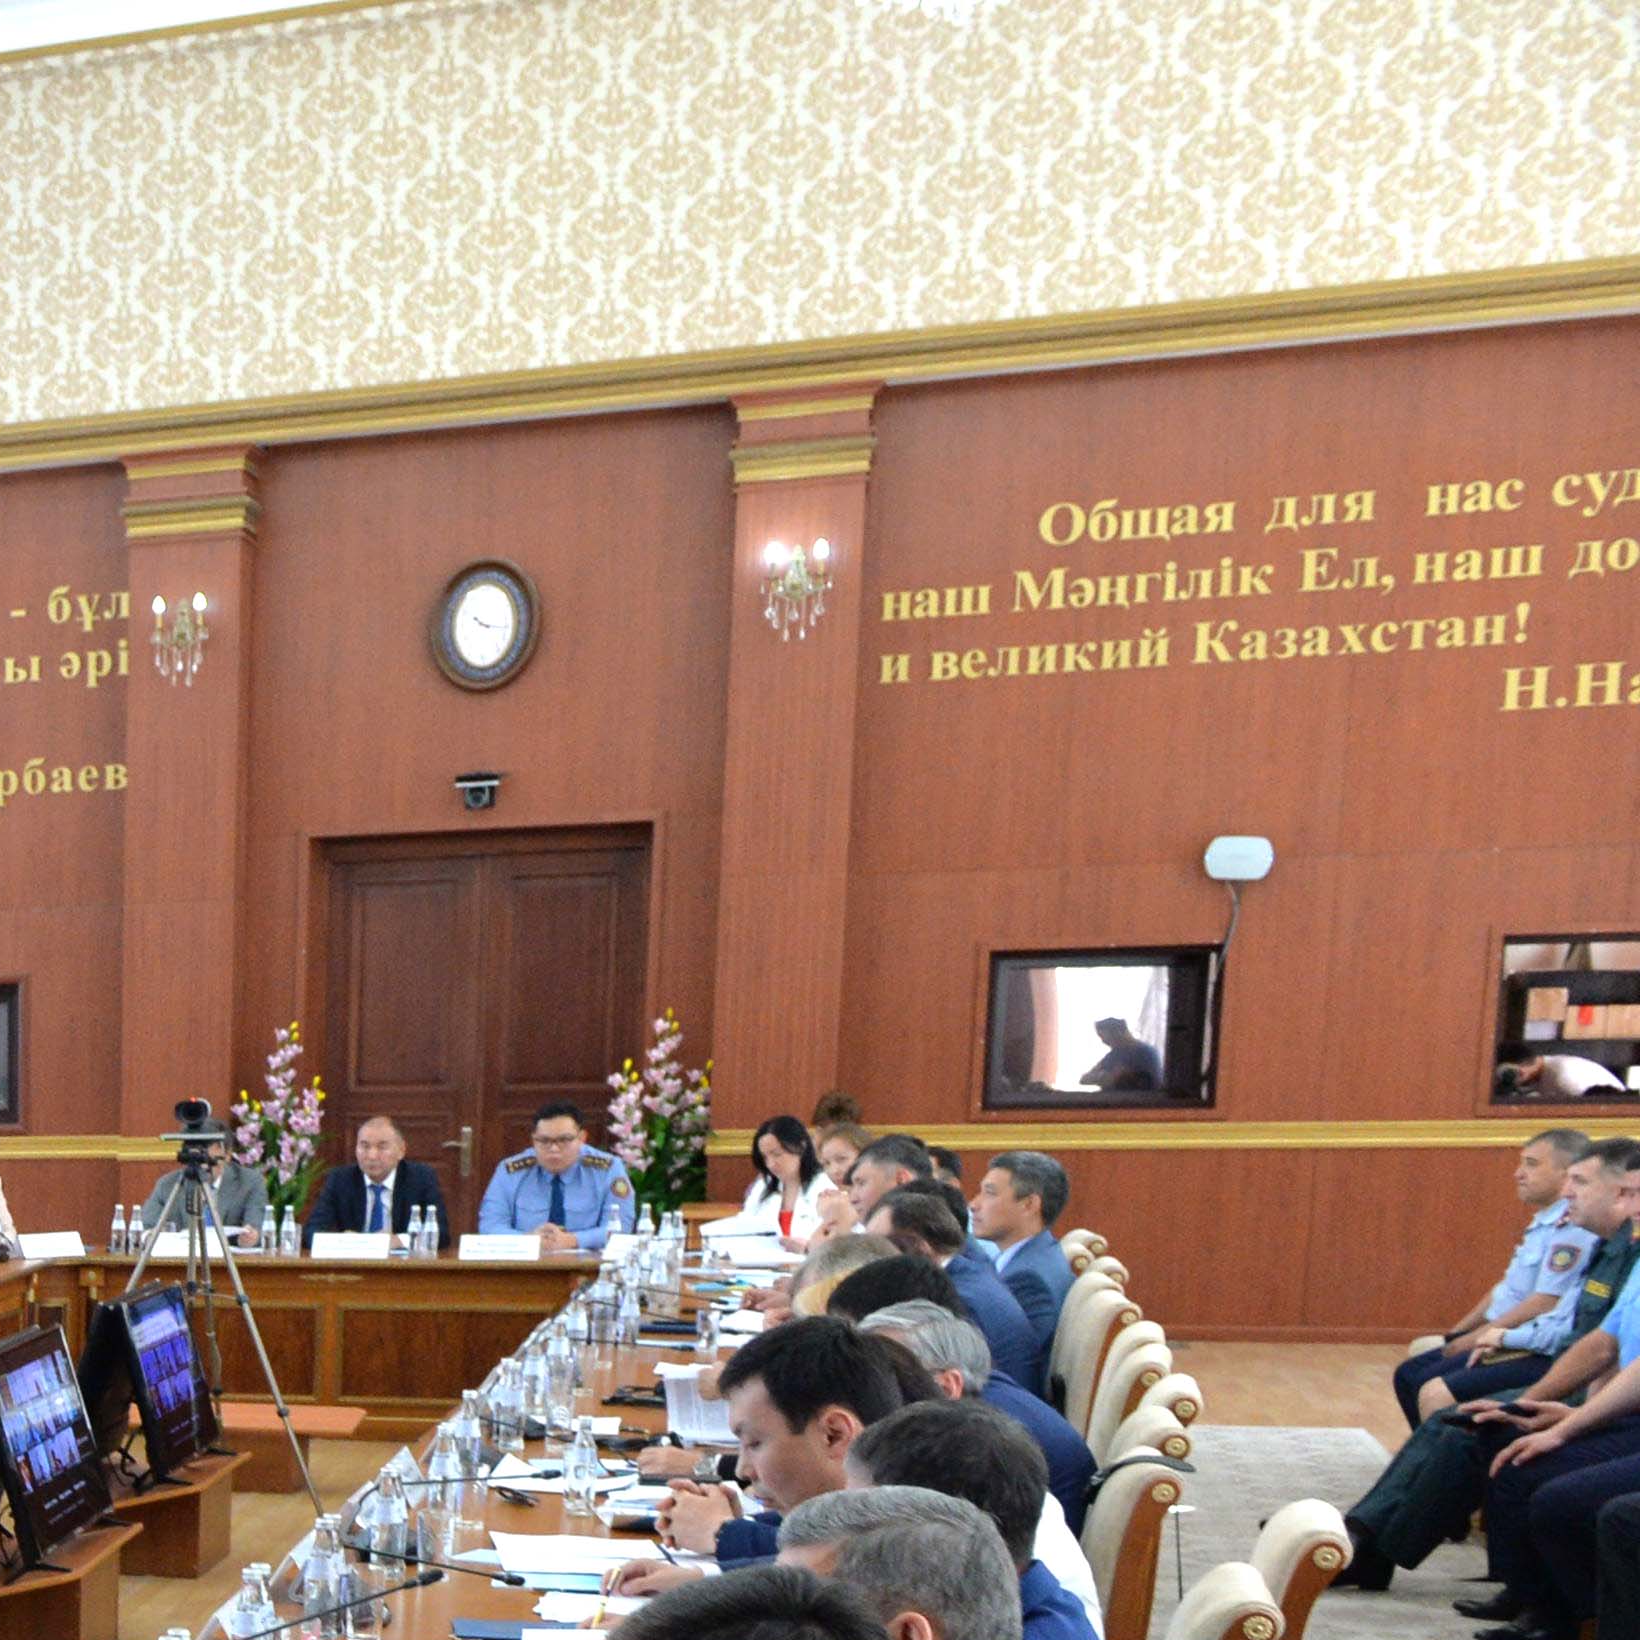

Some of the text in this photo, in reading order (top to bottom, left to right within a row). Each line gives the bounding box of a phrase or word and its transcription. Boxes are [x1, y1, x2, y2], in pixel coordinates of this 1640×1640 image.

[1037, 499, 1237, 547] Общая
[1263, 488, 1377, 535] для
[1424, 478, 1526, 518] нас
[46, 584, 131, 633] бұл
[880, 585, 993, 623] наш
[1010, 556, 1276, 613] Мәңгілік
[1298, 546, 1397, 595] Ел,
[1412, 543, 1546, 586] наш
[58, 638, 131, 689] әрі
[878, 600, 1532, 685] и великий Казахстан!
